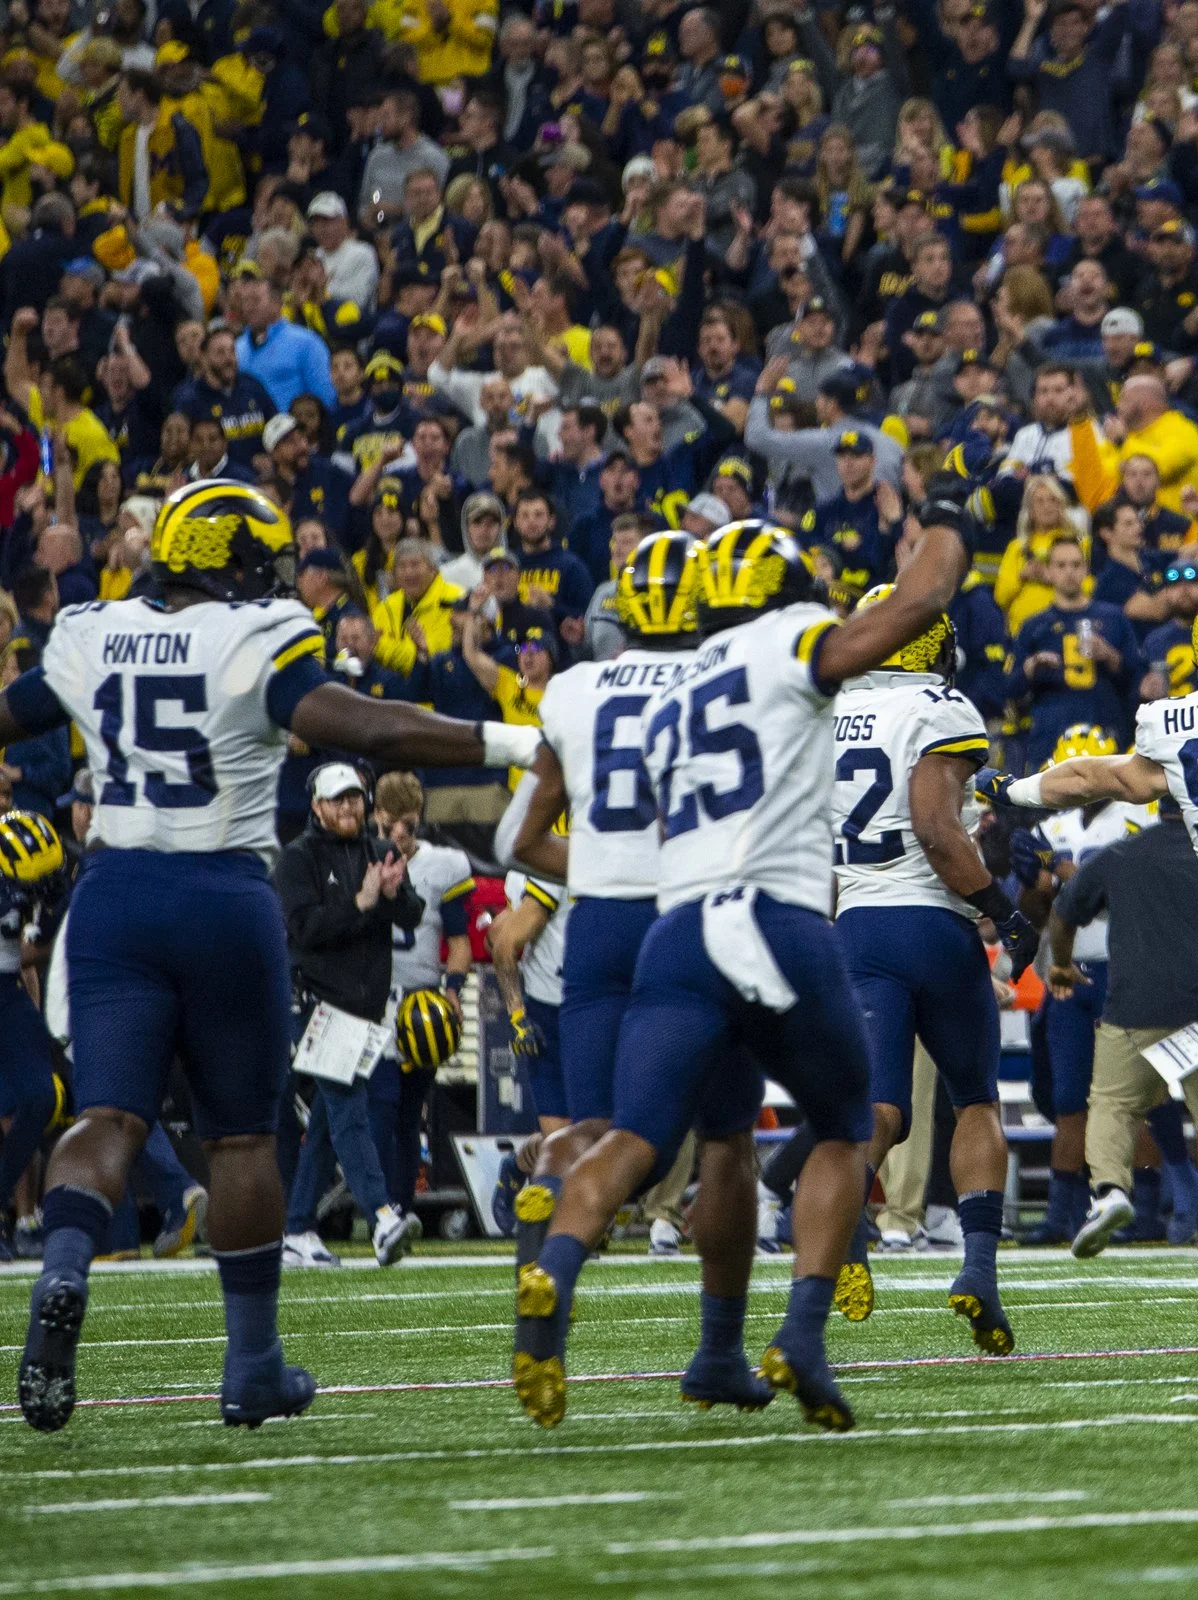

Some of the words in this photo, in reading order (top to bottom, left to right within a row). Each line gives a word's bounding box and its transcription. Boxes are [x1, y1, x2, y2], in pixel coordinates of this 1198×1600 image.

[103, 632, 193, 665] HINTON
[94, 672, 221, 809] 15
[834, 747, 907, 866] 2
